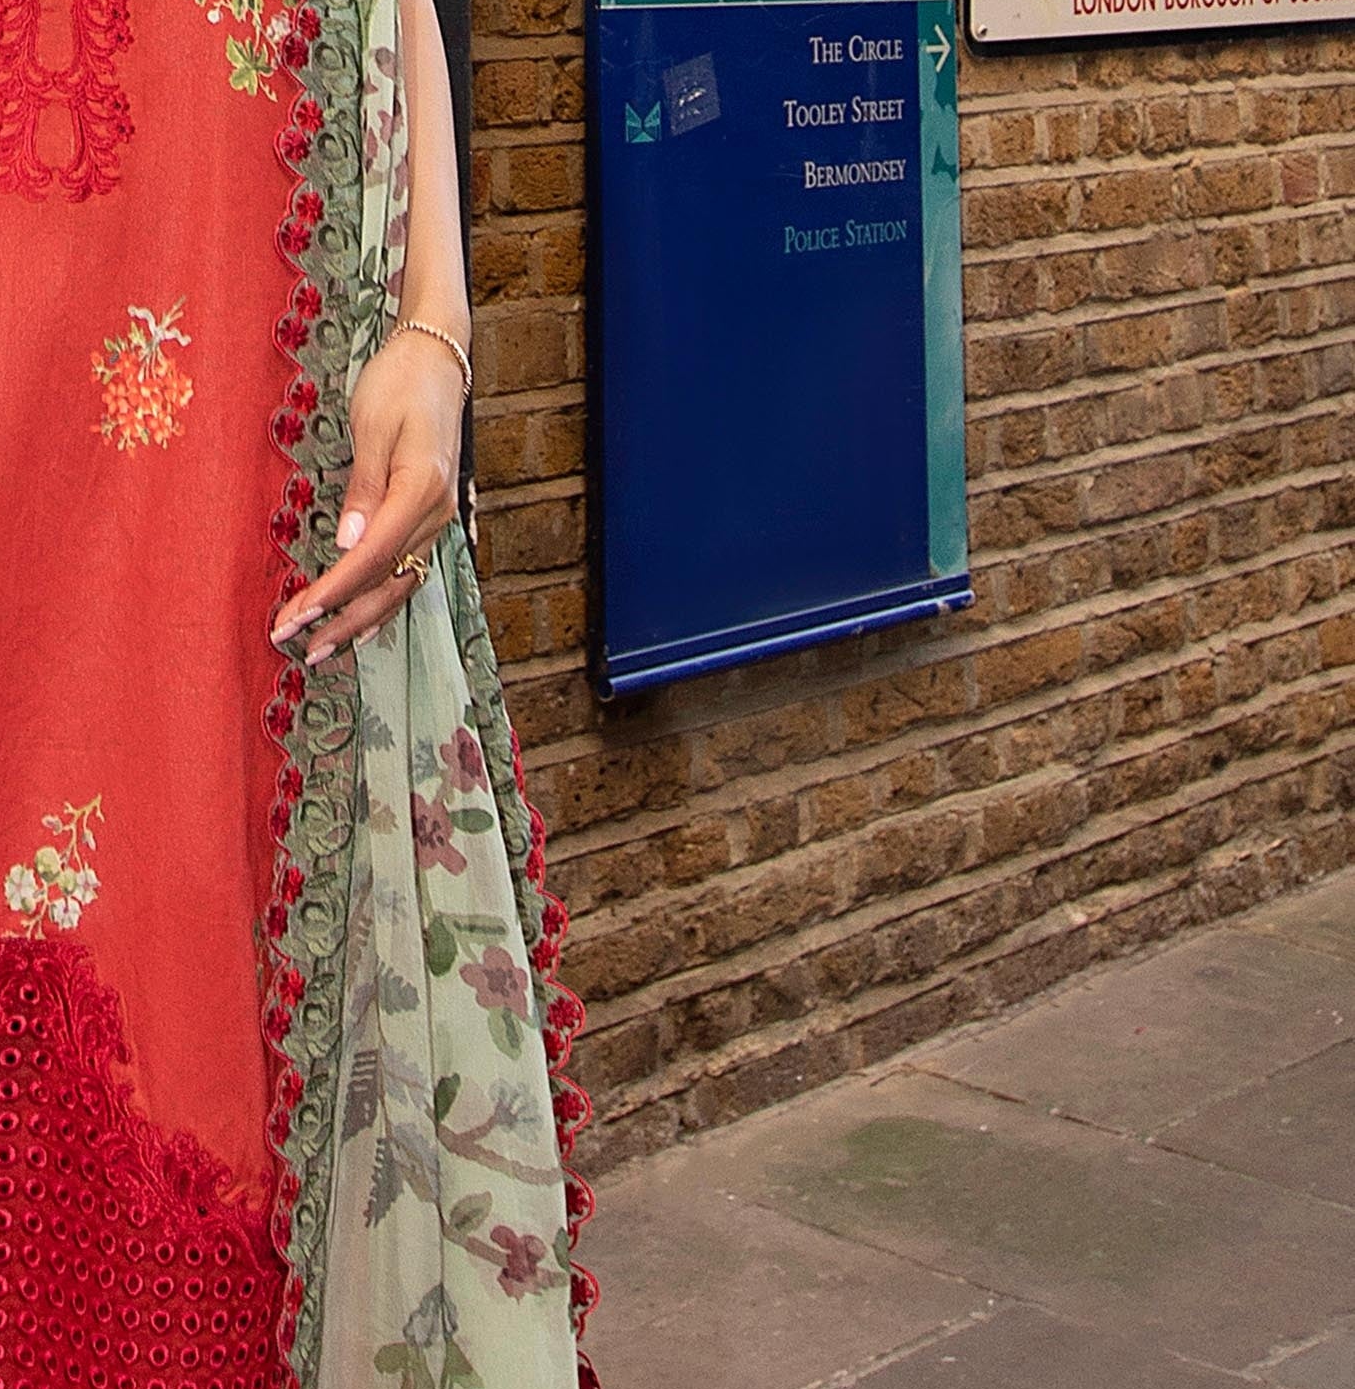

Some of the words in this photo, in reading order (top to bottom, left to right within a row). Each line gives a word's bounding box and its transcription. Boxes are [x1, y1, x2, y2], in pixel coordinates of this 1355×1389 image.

[809, 36, 843, 64] THE
[848, 35, 904, 62] CIRCLE
[783, 100, 846, 127] TOOLEY
[852, 95, 904, 123] STREET
[804, 159, 906, 189] BERMONDSEY
[784, 225, 841, 253] POLICE
[845, 219, 907, 246] STATION
